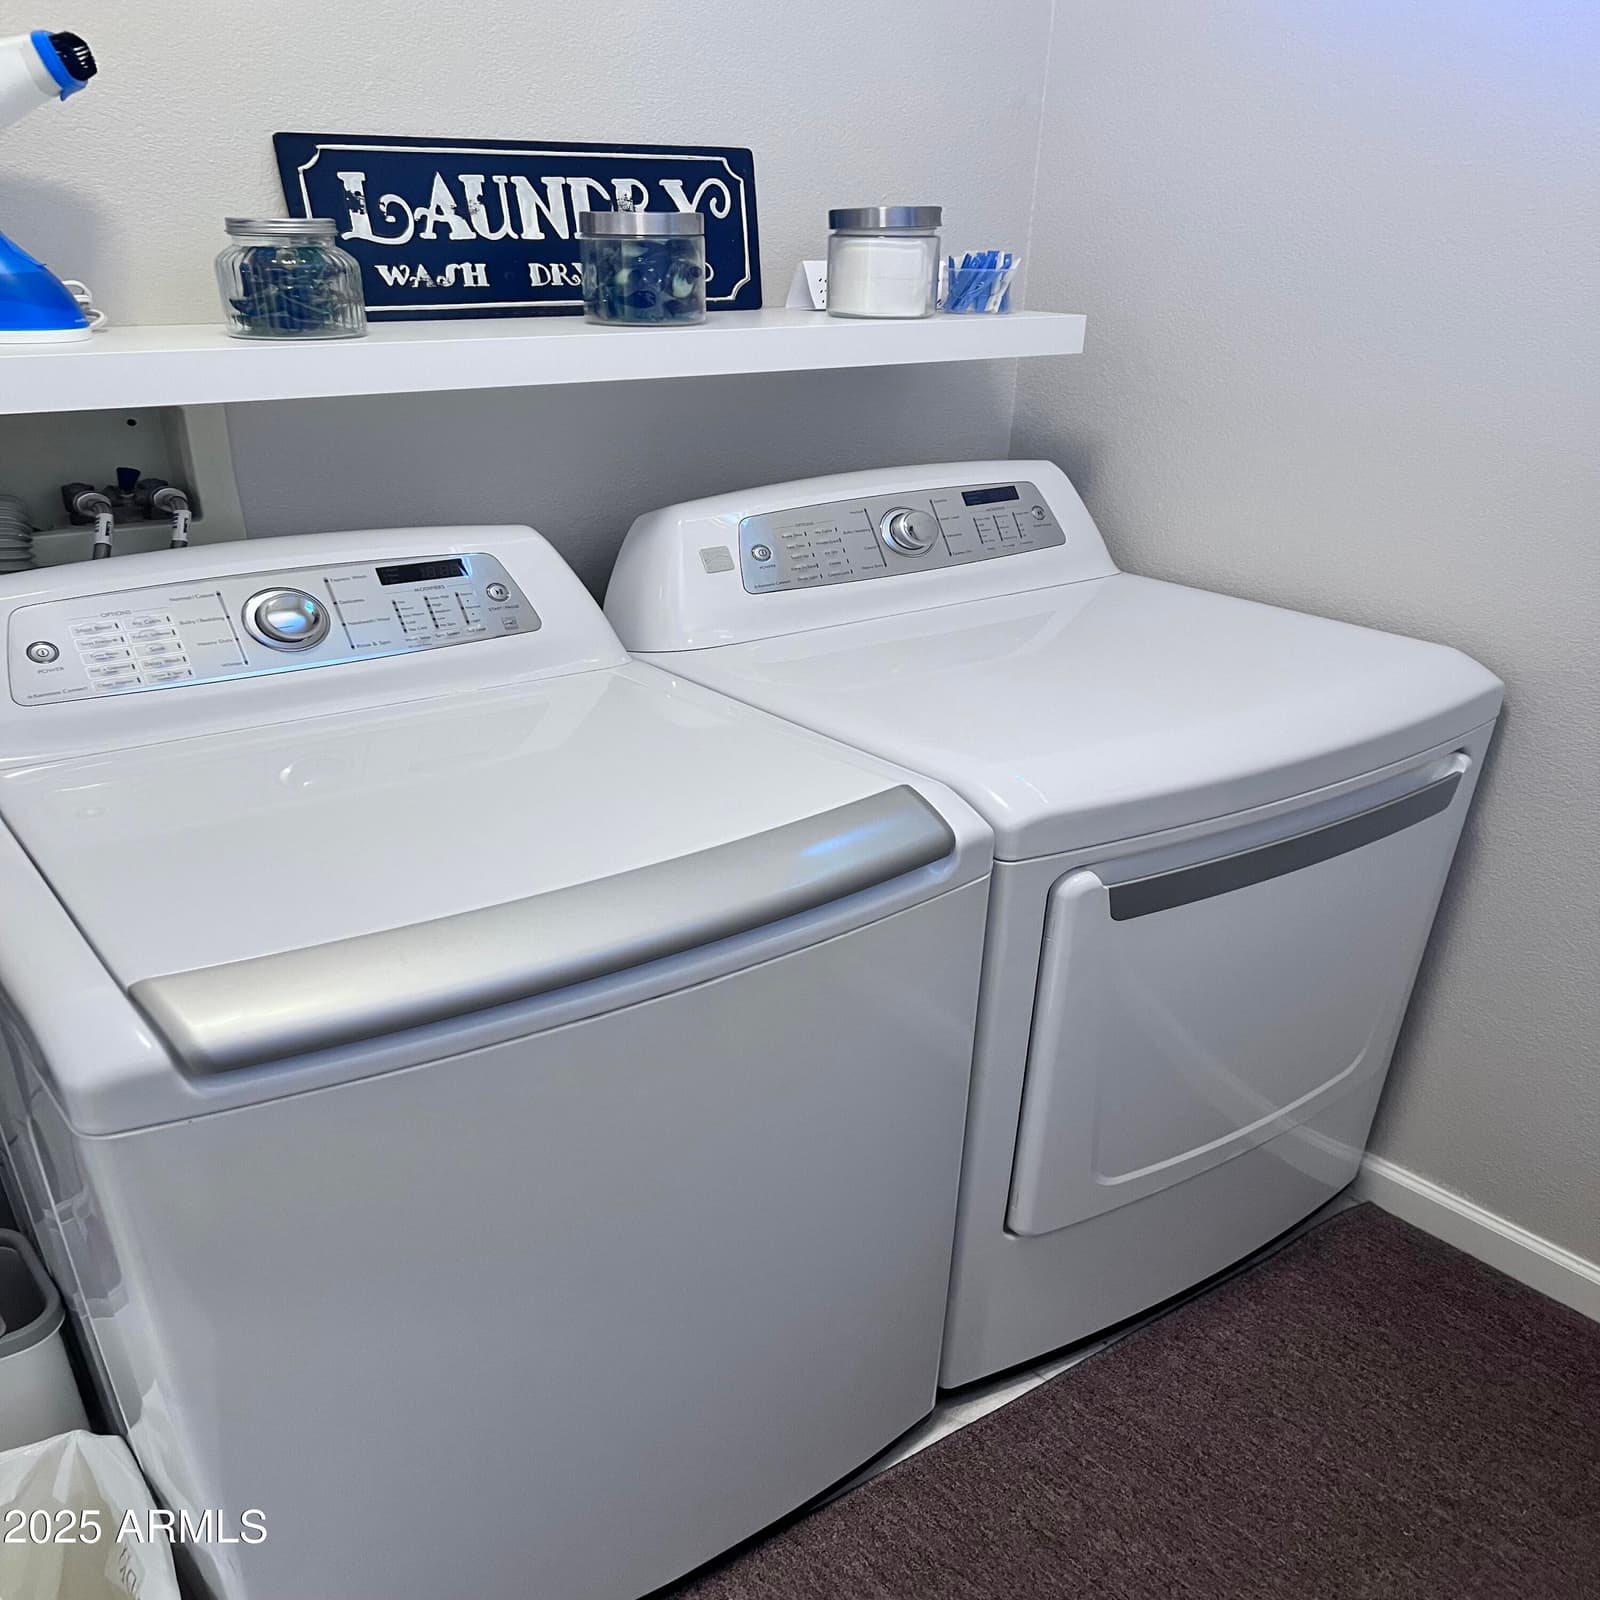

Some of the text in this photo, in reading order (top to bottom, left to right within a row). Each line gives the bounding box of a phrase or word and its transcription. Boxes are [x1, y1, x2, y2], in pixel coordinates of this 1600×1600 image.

[337, 171, 732, 245] LAUNDRY
[375, 261, 490, 288] WASH
[37, 665, 65, 674] POWER
